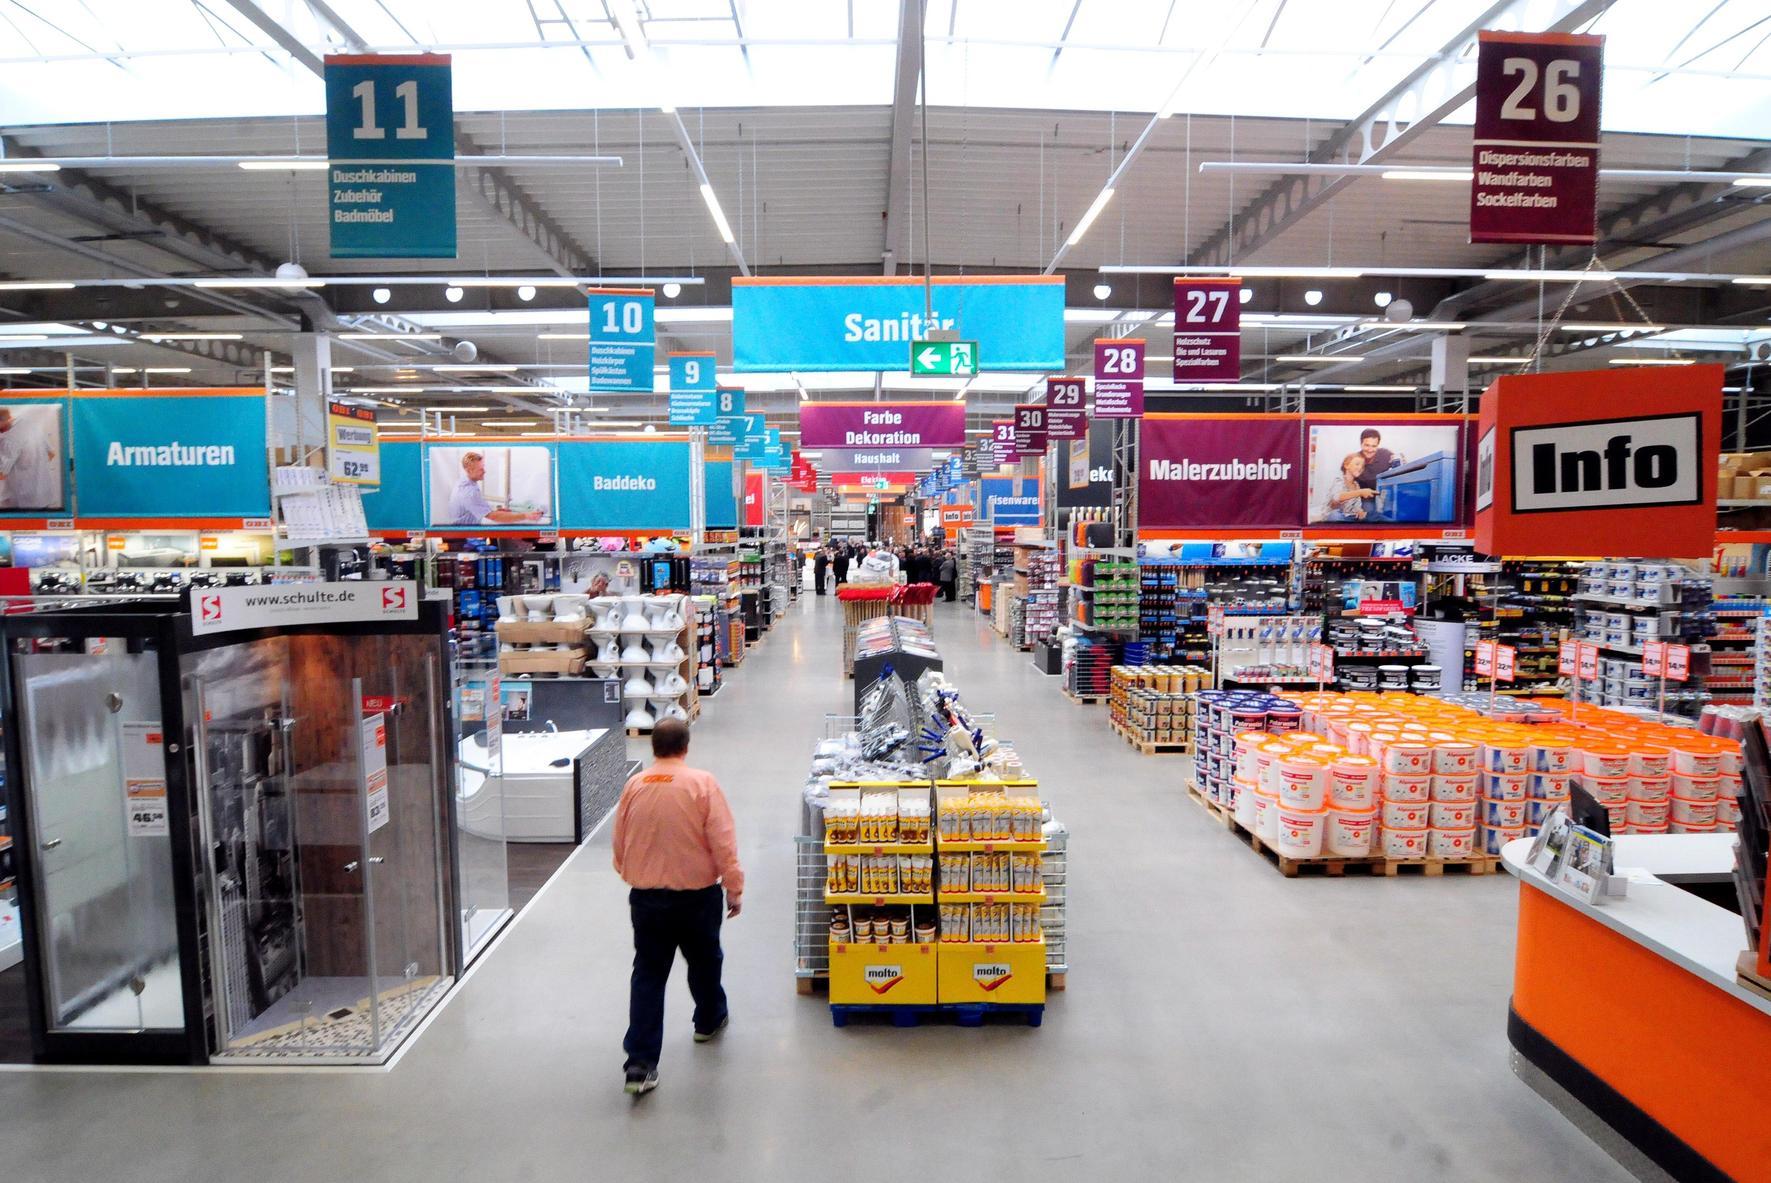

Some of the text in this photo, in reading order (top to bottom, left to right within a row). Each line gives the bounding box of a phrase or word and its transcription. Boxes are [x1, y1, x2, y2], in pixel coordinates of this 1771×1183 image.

[1500, 57, 1580, 123] 26
[352, 80, 428, 140] 11
[1479, 150, 1590, 168] Dispersionsfarben
[333, 168, 416, 184] Duschkabinen
[1478, 171, 1553, 187] Wandfarben
[334, 188, 382, 204] Zubehör
[1476, 192, 1558, 208] Sockelfarben
[334, 207, 394, 223] Badmöbel
[1186, 290, 1230, 323] 27
[602, 301, 643, 334] 10
[844, 311, 955, 342] Sanitär
[1176, 337, 1211, 346] Holzschutz
[1201, 347, 1228, 356] Lasuren
[1103, 348, 1137, 373] 28
[684, 360, 700, 384] 9
[720, 392, 733, 412] 8
[1053, 384, 1080, 405] 29
[744, 416, 754, 432] 7
[863, 410, 902, 425] Farbe
[1020, 411, 1042, 428] 30
[845, 431, 921, 445] Dekoration
[997, 425, 1016, 440] 31
[107, 441, 235, 467] Armaturen
[854, 453, 901, 464] Haushalt
[1149, 457, 1291, 482] Malerzubehör
[1532, 434, 1678, 495] Info
[594, 475, 656, 490] Baddeko
[945, 512, 959, 521] Info
[1434, 554, 1474, 563] LACKE
[245, 591, 356, 607] www.schulte.de
[366, 698, 383, 708] NEU
[868, 967, 1006, 978] molto molto
